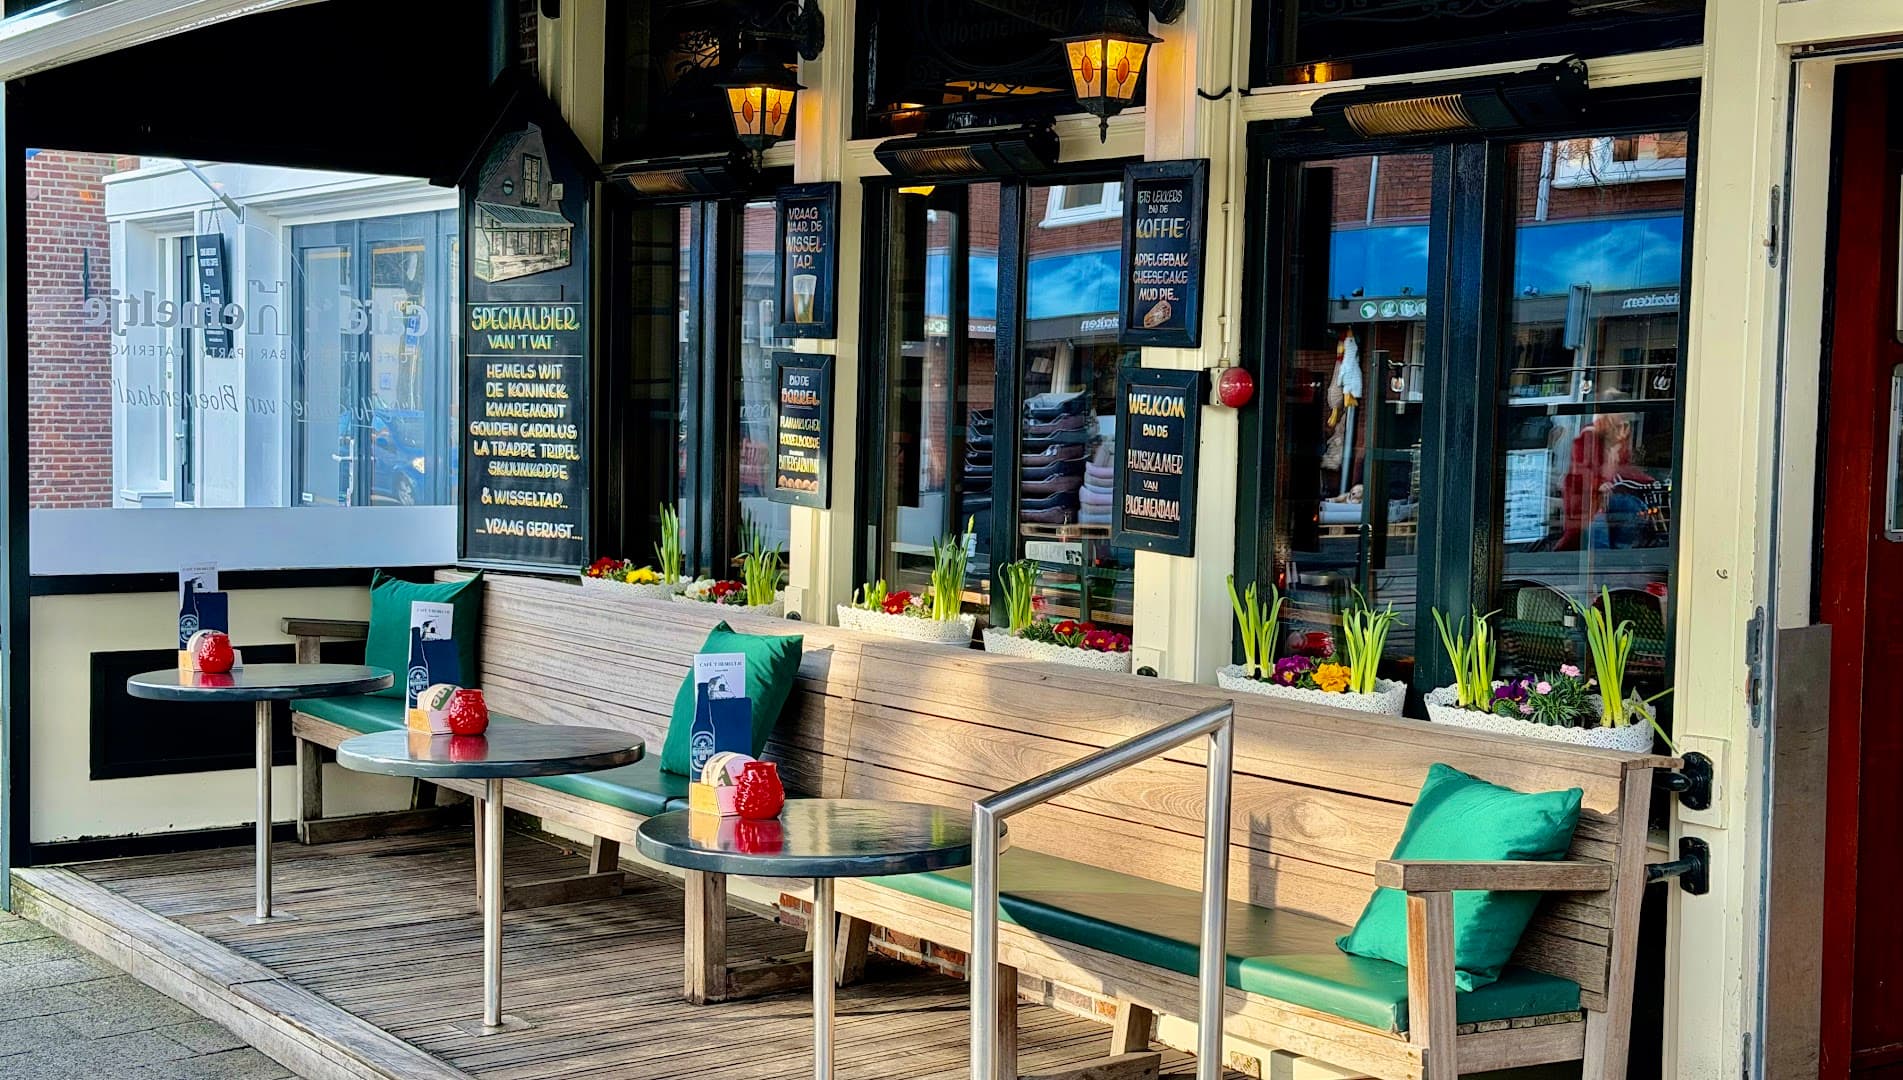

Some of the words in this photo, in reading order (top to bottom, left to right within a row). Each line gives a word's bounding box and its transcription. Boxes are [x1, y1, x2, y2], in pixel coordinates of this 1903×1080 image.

[788, 206, 818, 221] VRAAG
[1159, 204, 1168, 214] DE
[810, 220, 823, 232] DE
[1134, 252, 1189, 267] APPELGEBAK
[1132, 270, 1189, 285] CHEESECAKE
[1138, 288, 1158, 301] MUD
[471, 306, 580, 331] SPECIAALBIER
[487, 334, 516, 350] VAN
[486, 363, 537, 379] HEMELS
[538, 363, 563, 380] WIT
[485, 381, 504, 398] DE
[507, 382, 569, 399] KONINCK
[485, 401, 567, 418] KWAREMONT
[1128, 393, 1185, 419] WELKOM
[470, 421, 519, 436] GOUDEN
[520, 423, 578, 440] CAROLUS
[1157, 425, 1168, 438] DE
[473, 440, 490, 456] LA
[491, 441, 537, 458] TRAPPE
[540, 443, 581, 461] TRIPEL
[1127, 449, 1184, 475] HUISKAMER
[1142, 479, 1159, 491] VAN
[481, 486, 492, 505] &
[1125, 494, 1180, 521] BLOEMENDAAL
